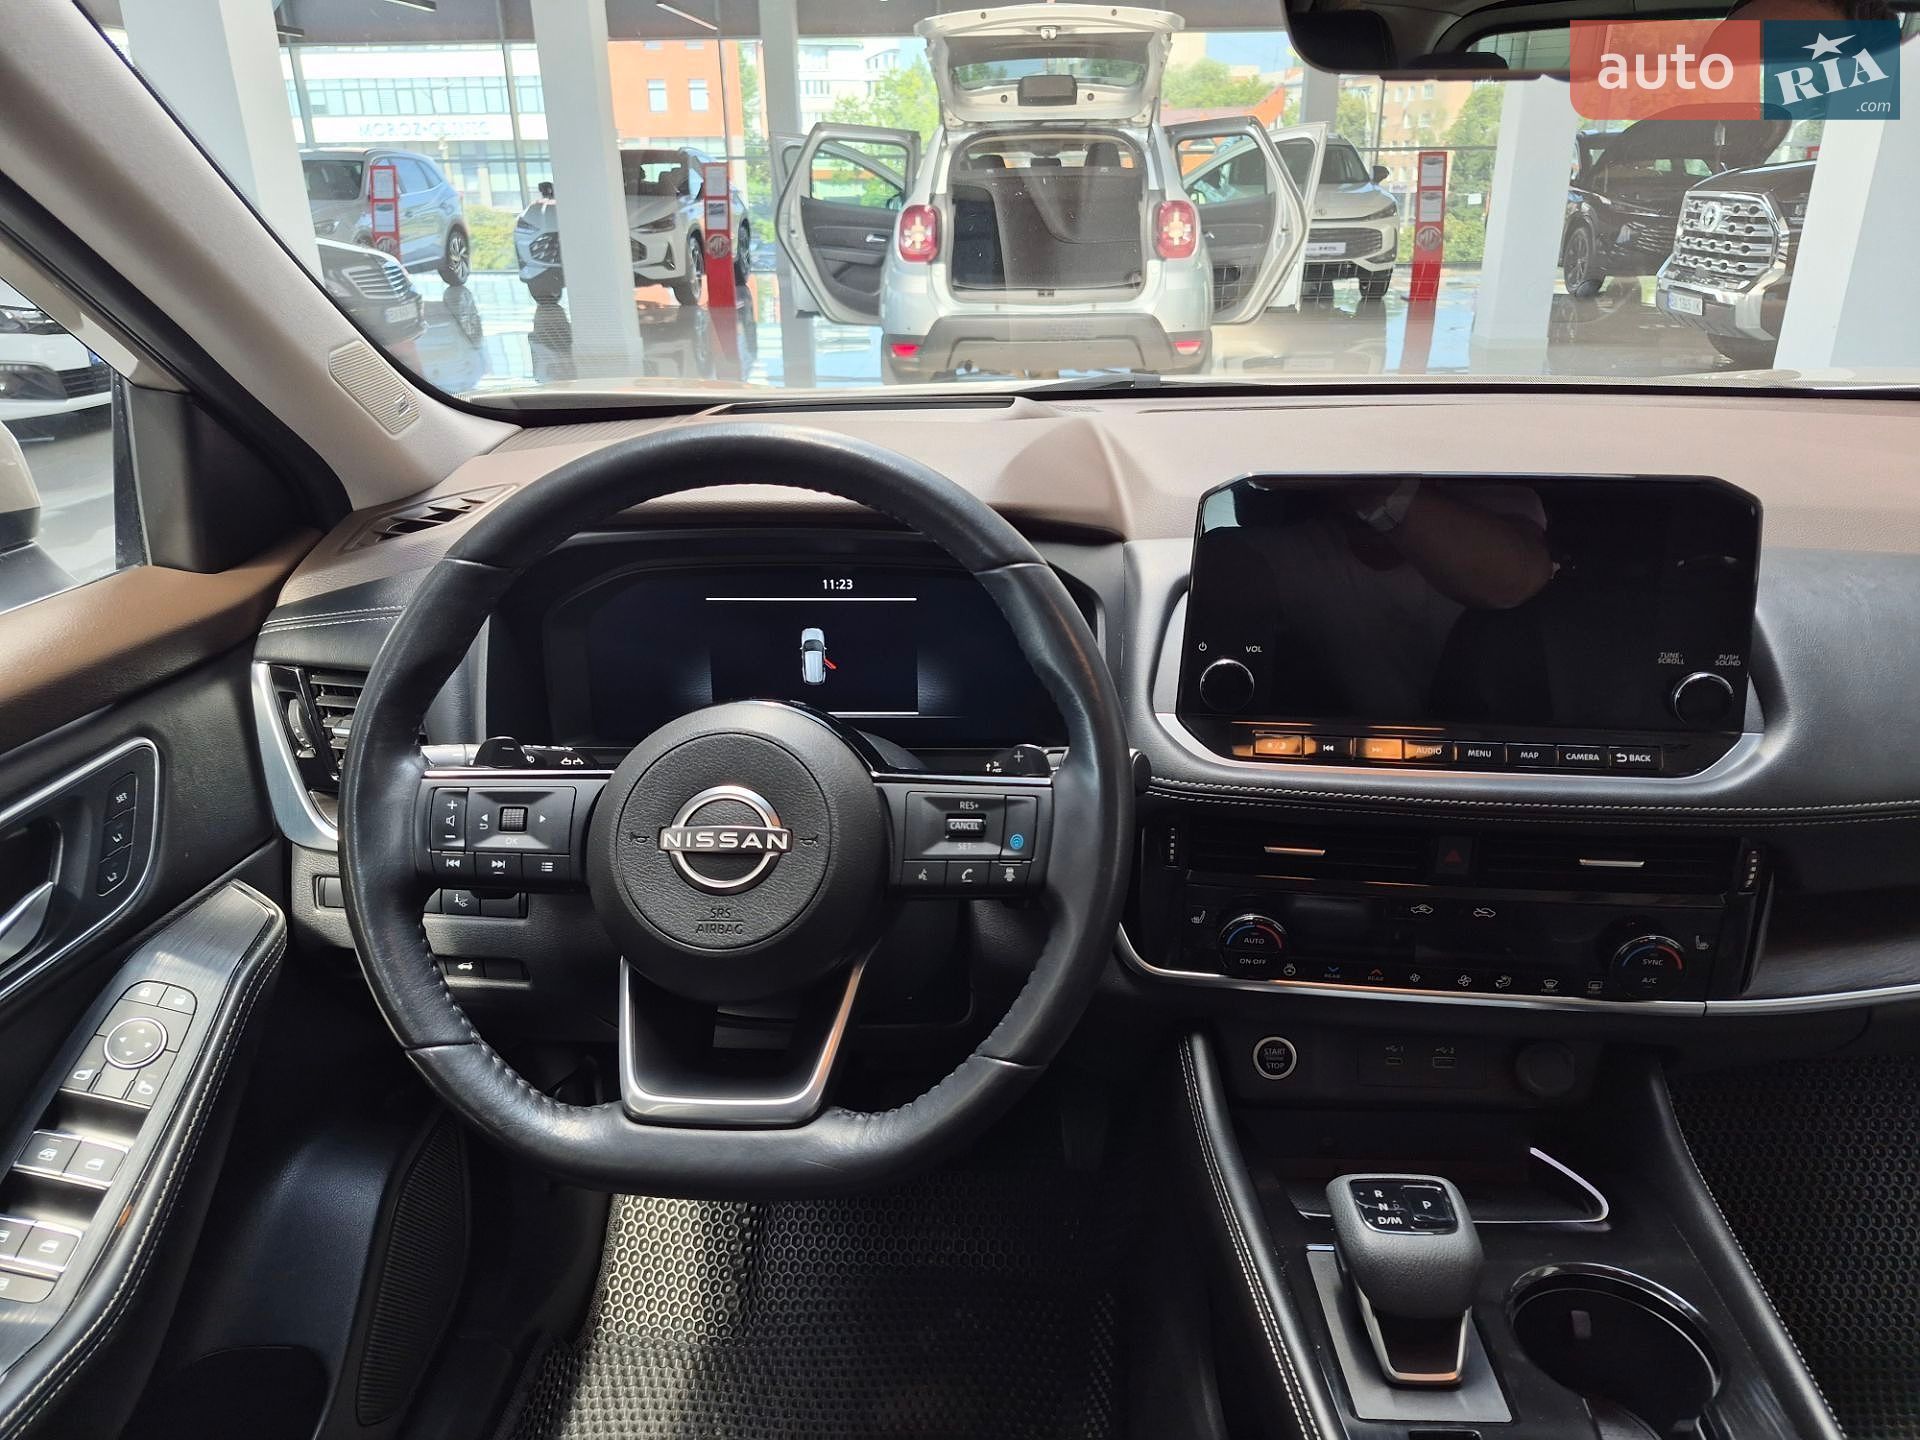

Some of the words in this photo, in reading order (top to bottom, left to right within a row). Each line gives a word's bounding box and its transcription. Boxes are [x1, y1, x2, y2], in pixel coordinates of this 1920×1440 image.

[822, 579, 853, 590] 11:23
[1245, 645, 1263, 653] VOL
[1416, 747, 1442, 755] AUDIO
[1467, 749, 1492, 757] MENU
[1520, 751, 1539, 759] MAP
[1565, 753, 1600, 761] CAMERA
[1629, 754, 1652, 762] BACK
[115, 792, 128, 804] SET
[959, 801, 979, 810] RES+
[950, 822, 980, 830] CANCEL
[662, 831, 788, 850] NISSAN
[710, 908, 731, 919] SRS
[695, 923, 744, 936] AIRBAG
[1243, 937, 1265, 945] AUTO
[1642, 958, 1664, 966] SYNC
[1374, 1189, 1384, 1198] R
[1378, 1202, 1389, 1211] N
[1422, 1200, 1432, 1210] P
[1377, 1216, 1403, 1225] D/M
